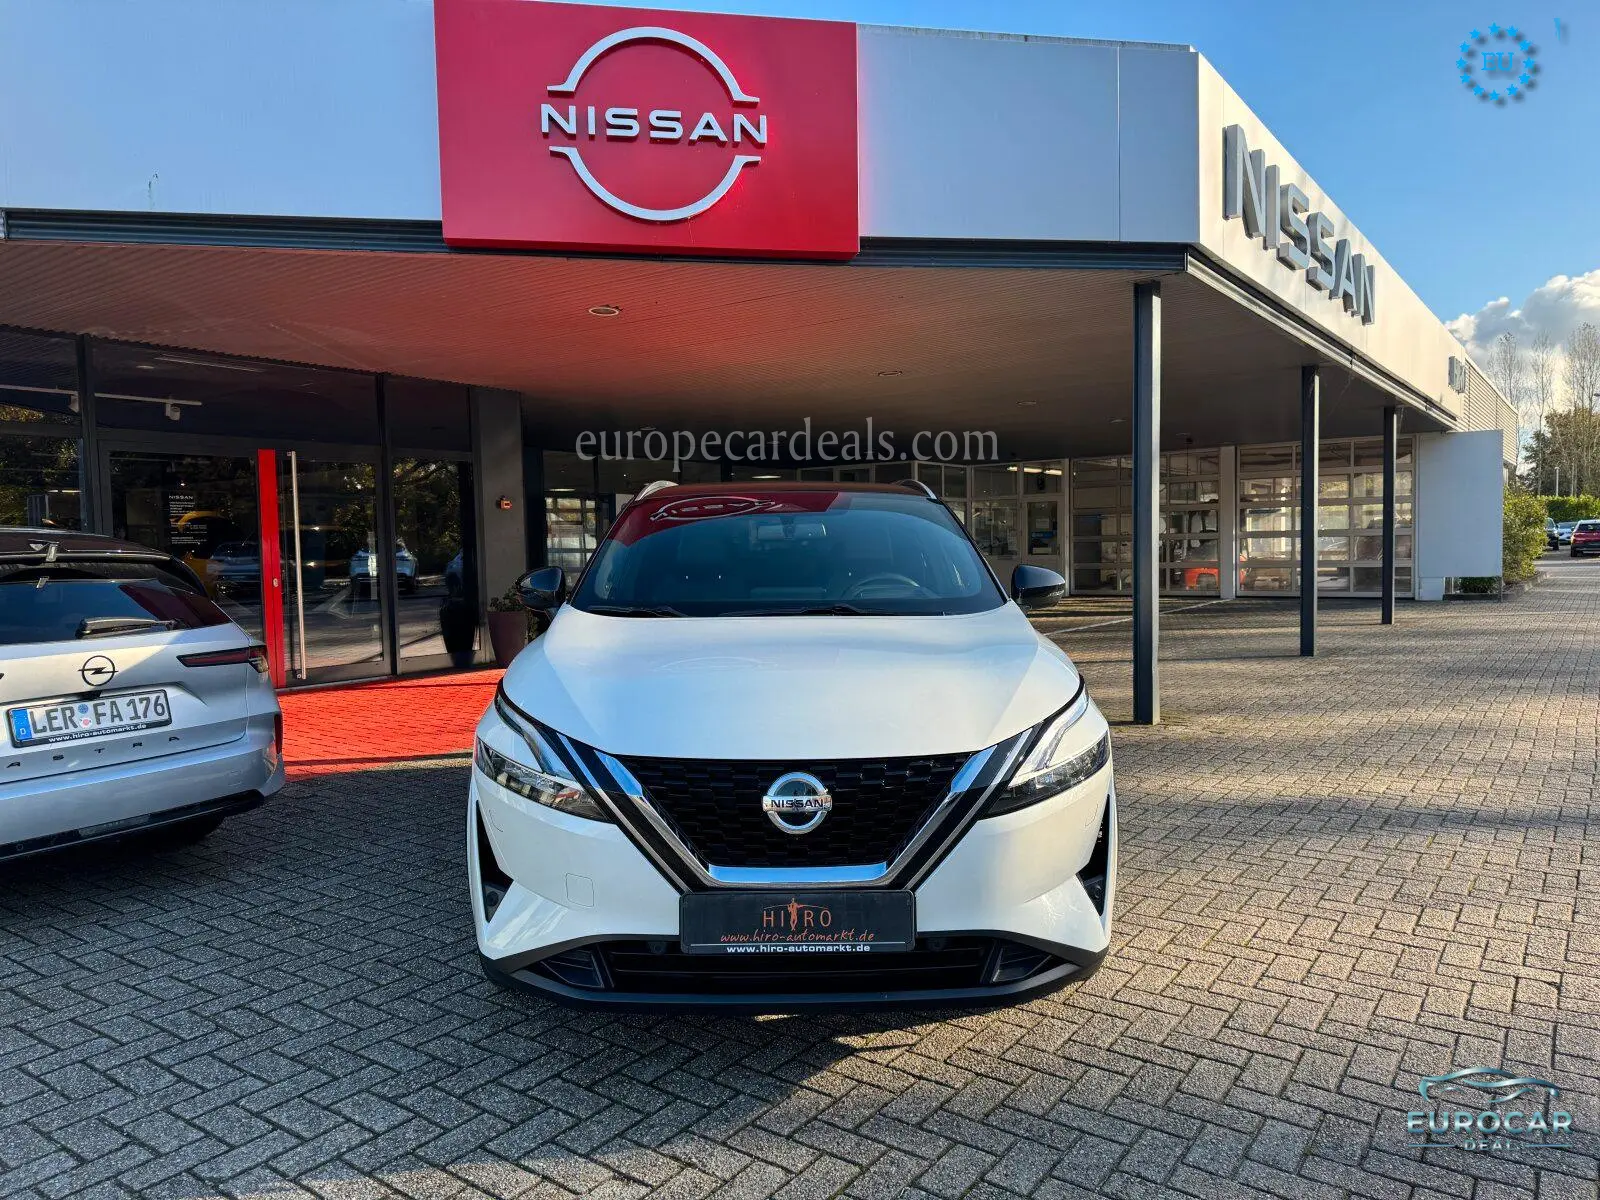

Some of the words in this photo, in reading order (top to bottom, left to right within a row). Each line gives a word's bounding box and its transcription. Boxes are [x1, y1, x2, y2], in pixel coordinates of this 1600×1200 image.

[540, 103, 768, 145] NISSAN
[1222, 123, 1377, 326] NISSAN
[29, 706, 78, 734] LER
[92, 700, 123, 725] FA
[127, 695, 166, 721] 176
[48, 724, 147, 744] www.hiro-automarkt.de
[6, 736, 180, 768] ASTRA
[770, 798, 825, 809] NISSAN
[720, 929, 874, 942] www.hiro-automarkt.de
[726, 943, 871, 953] www.hiro-automarkt.de
